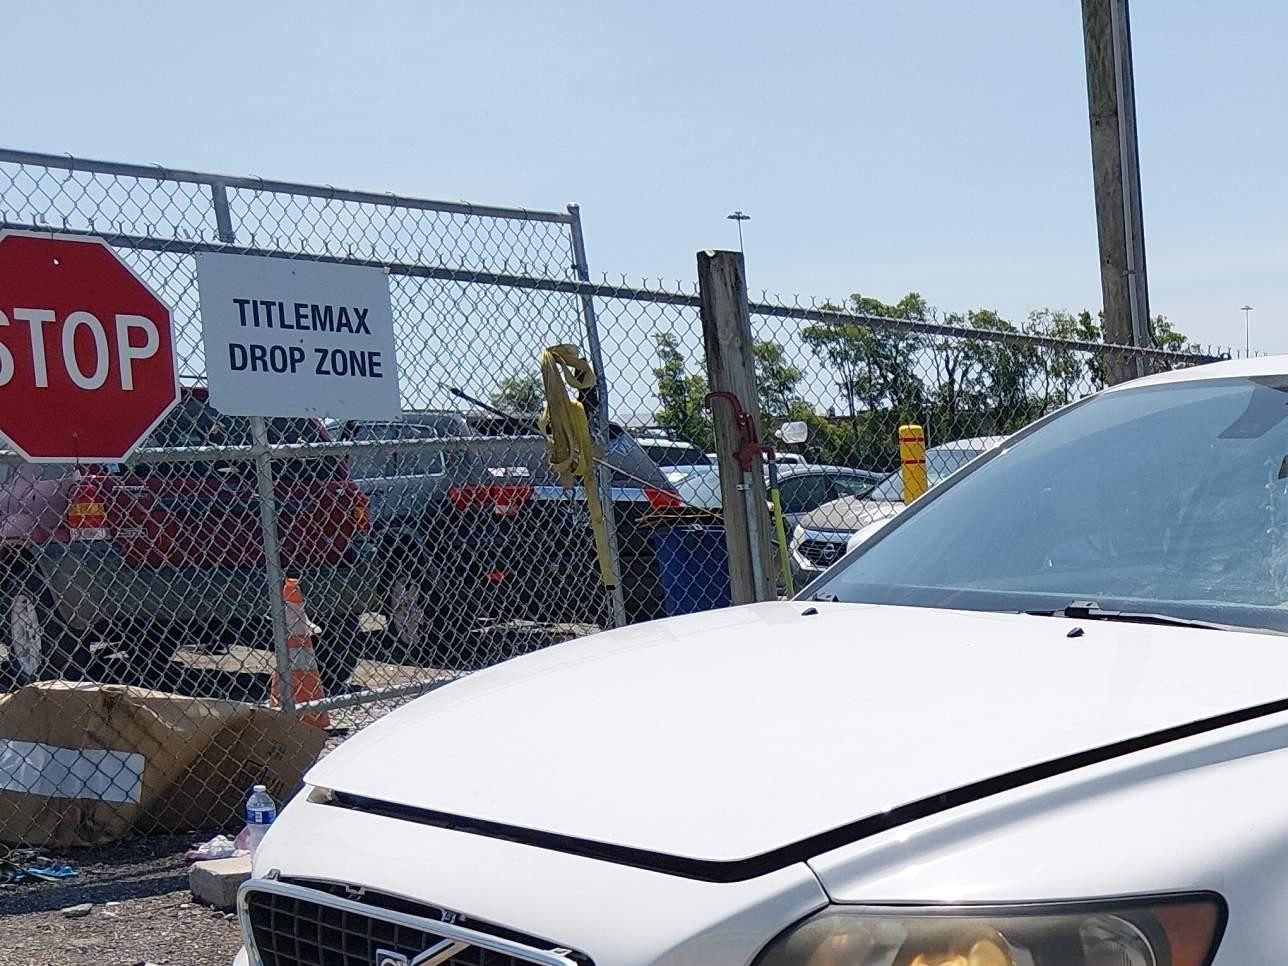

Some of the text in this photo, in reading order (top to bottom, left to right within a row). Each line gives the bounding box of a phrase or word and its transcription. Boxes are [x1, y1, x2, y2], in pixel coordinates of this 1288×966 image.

[233, 298, 371, 335] TITLEMAX
[228, 343, 383, 378] DROP ZONE
